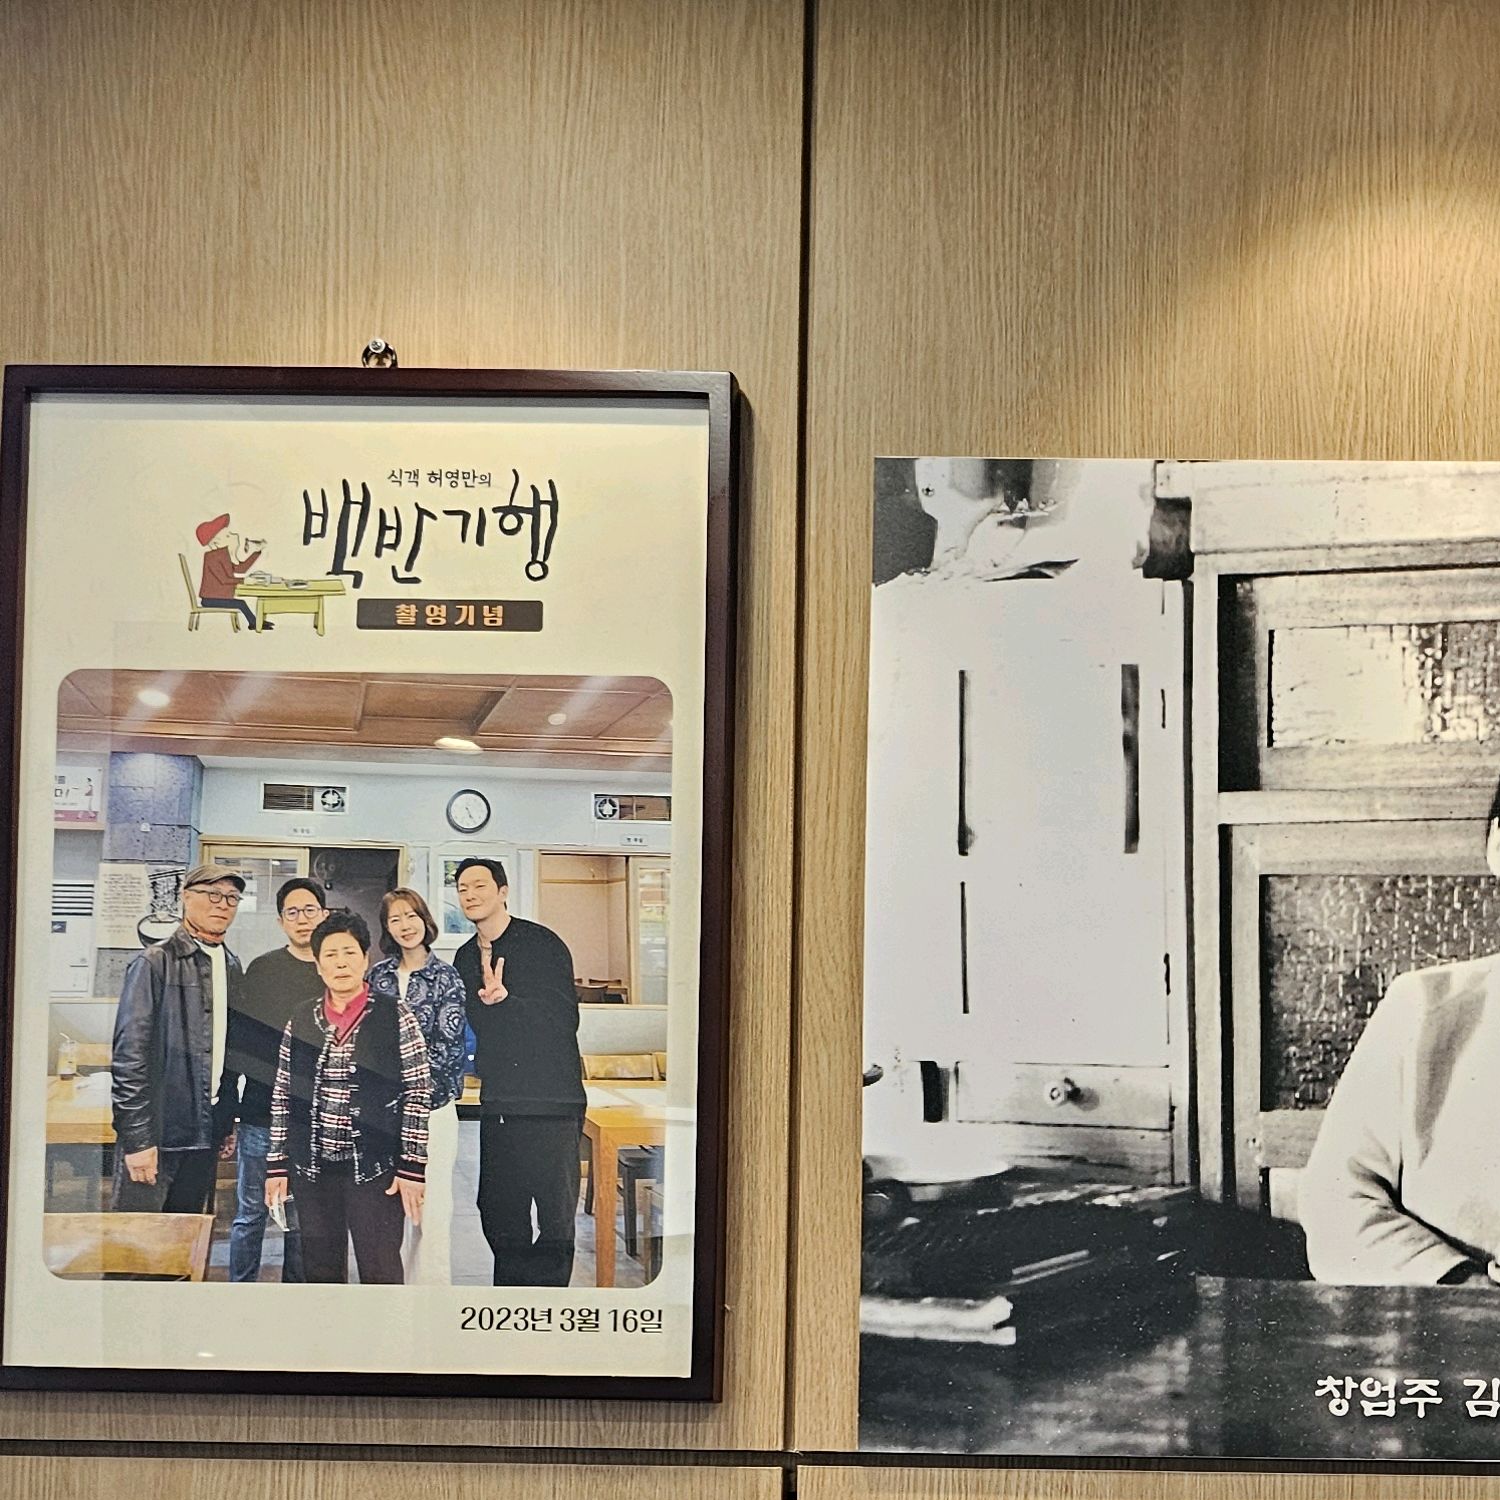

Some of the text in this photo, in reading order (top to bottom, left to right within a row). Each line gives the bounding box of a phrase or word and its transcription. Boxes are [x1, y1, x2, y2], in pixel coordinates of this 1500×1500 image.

[386, 467, 494, 488] 식객 허영만의
[303, 468, 559, 589] 백반기행
[394, 603, 505, 628] 촬영기념
[460, 1306, 663, 1334] 2023년 3월 16일
[1314, 1371, 1443, 1419] 창업주
